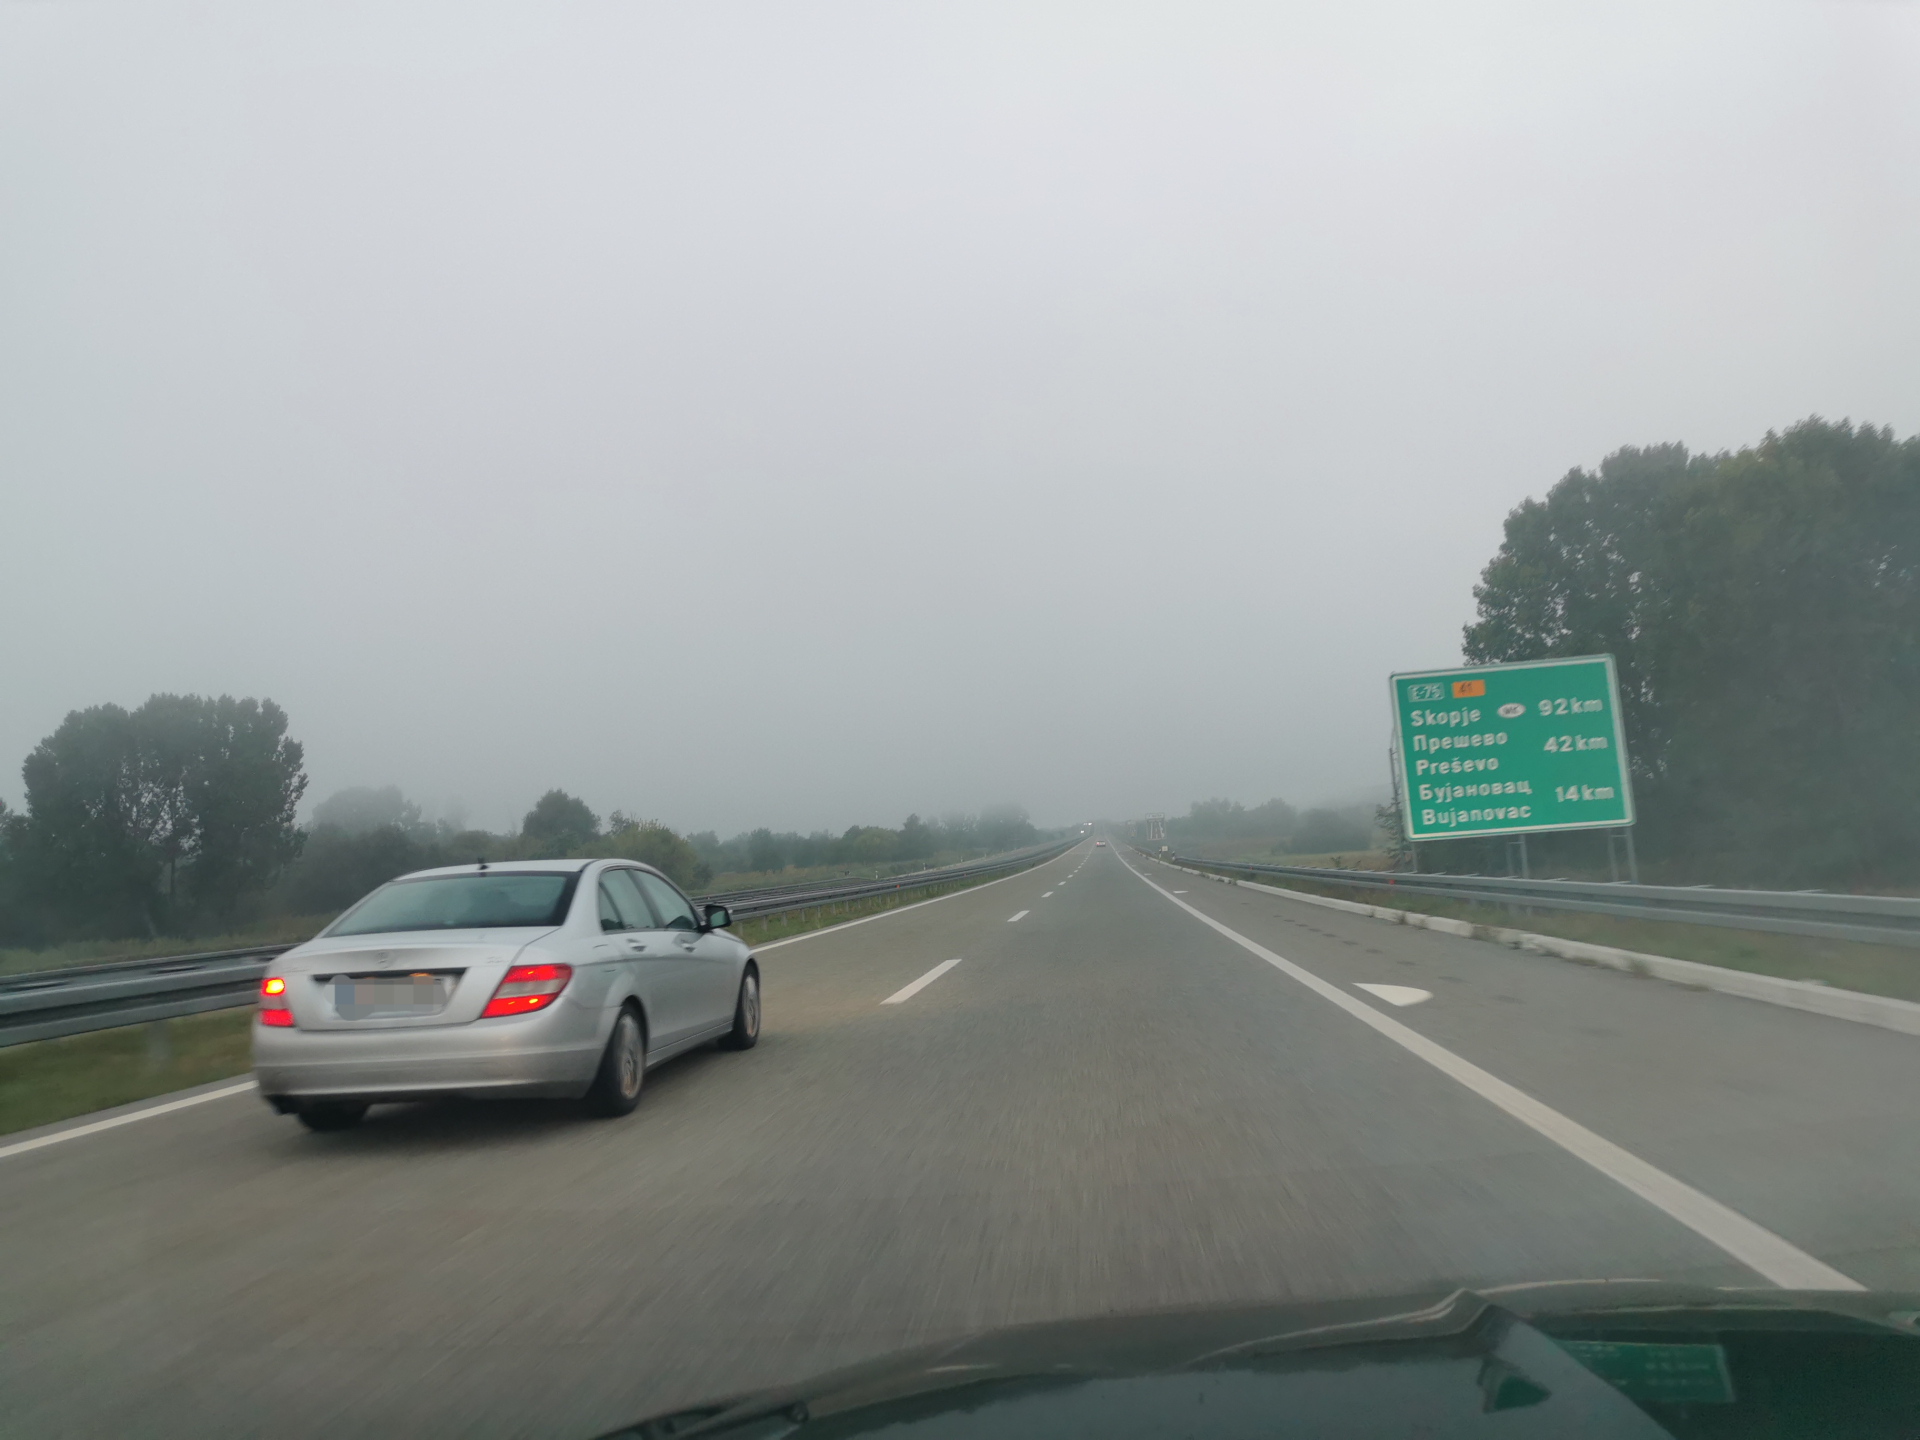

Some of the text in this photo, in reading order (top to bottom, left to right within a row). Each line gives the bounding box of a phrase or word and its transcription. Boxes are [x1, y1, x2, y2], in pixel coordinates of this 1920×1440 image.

[1410, 706, 1481, 727] Skopje
[1413, 732, 1508, 754] Прешево
[1416, 757, 1499, 776] Preševo
[1419, 780, 1533, 803] Бујановац
[1421, 805, 1531, 827] Bujanovac
